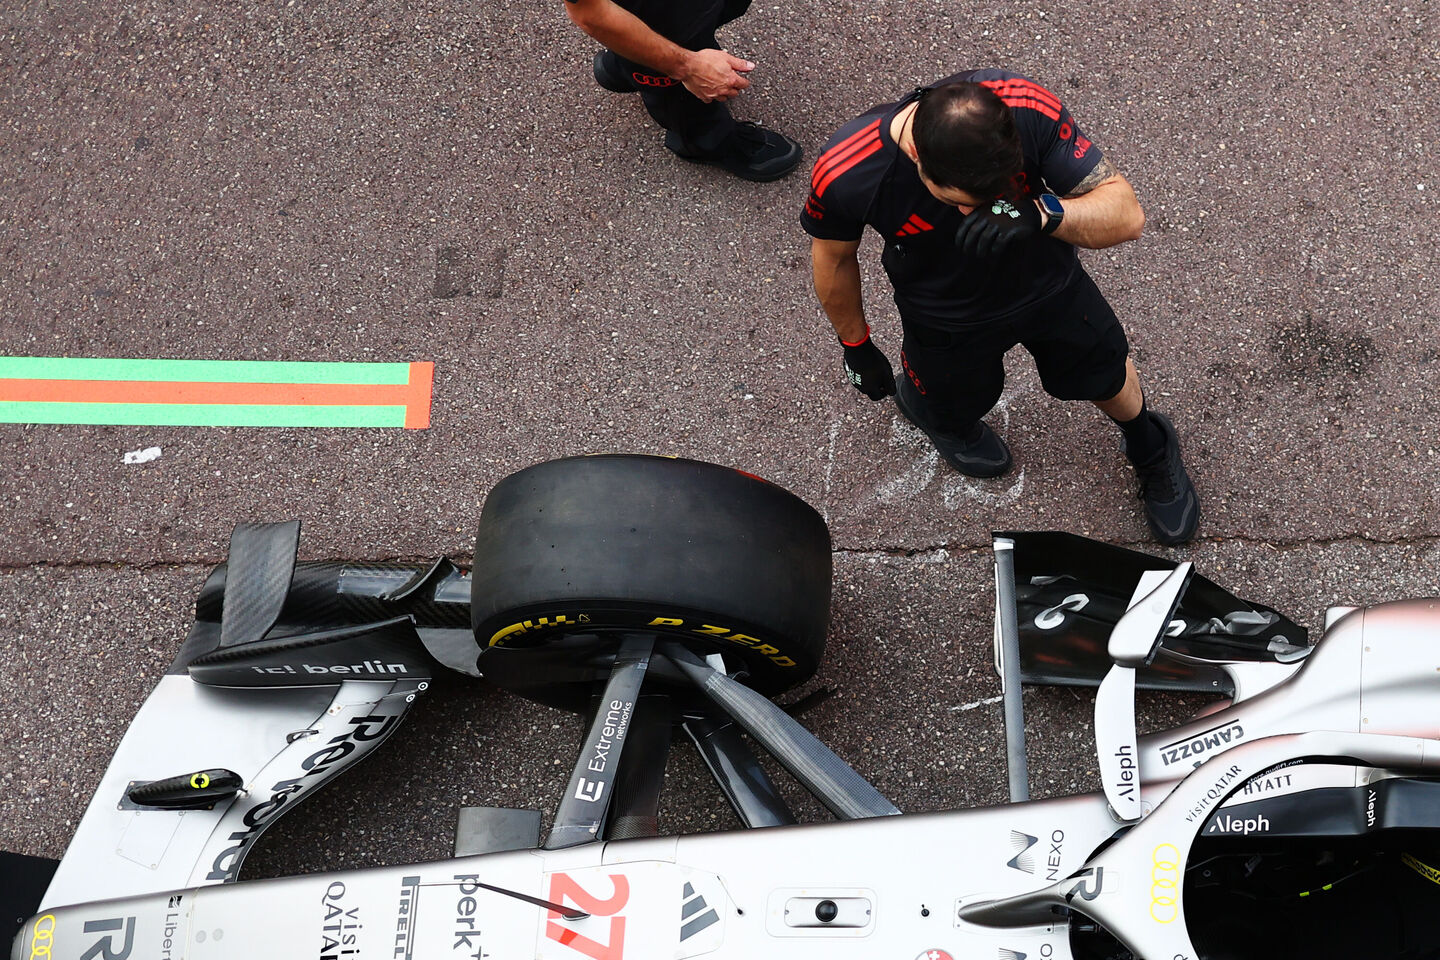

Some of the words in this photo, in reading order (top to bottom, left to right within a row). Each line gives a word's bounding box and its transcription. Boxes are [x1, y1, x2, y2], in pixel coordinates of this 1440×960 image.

[302, 660, 408, 674] berlin
[691, 623, 798, 668] ZERO
[587, 700, 623, 772] Extreme
[616, 702, 633, 740] networks
[1161, 724, 1245, 767] CAMOZZI
[1116, 744, 1135, 803] Aleph
[1185, 797, 1211, 824] visit
[1206, 764, 1243, 801] QATAR
[1243, 774, 1293, 796] HYATT
[1209, 814, 1270, 836] Aleph
[1367, 789, 1377, 828] Aleph
[1045, 828, 1065, 881] NEXO
